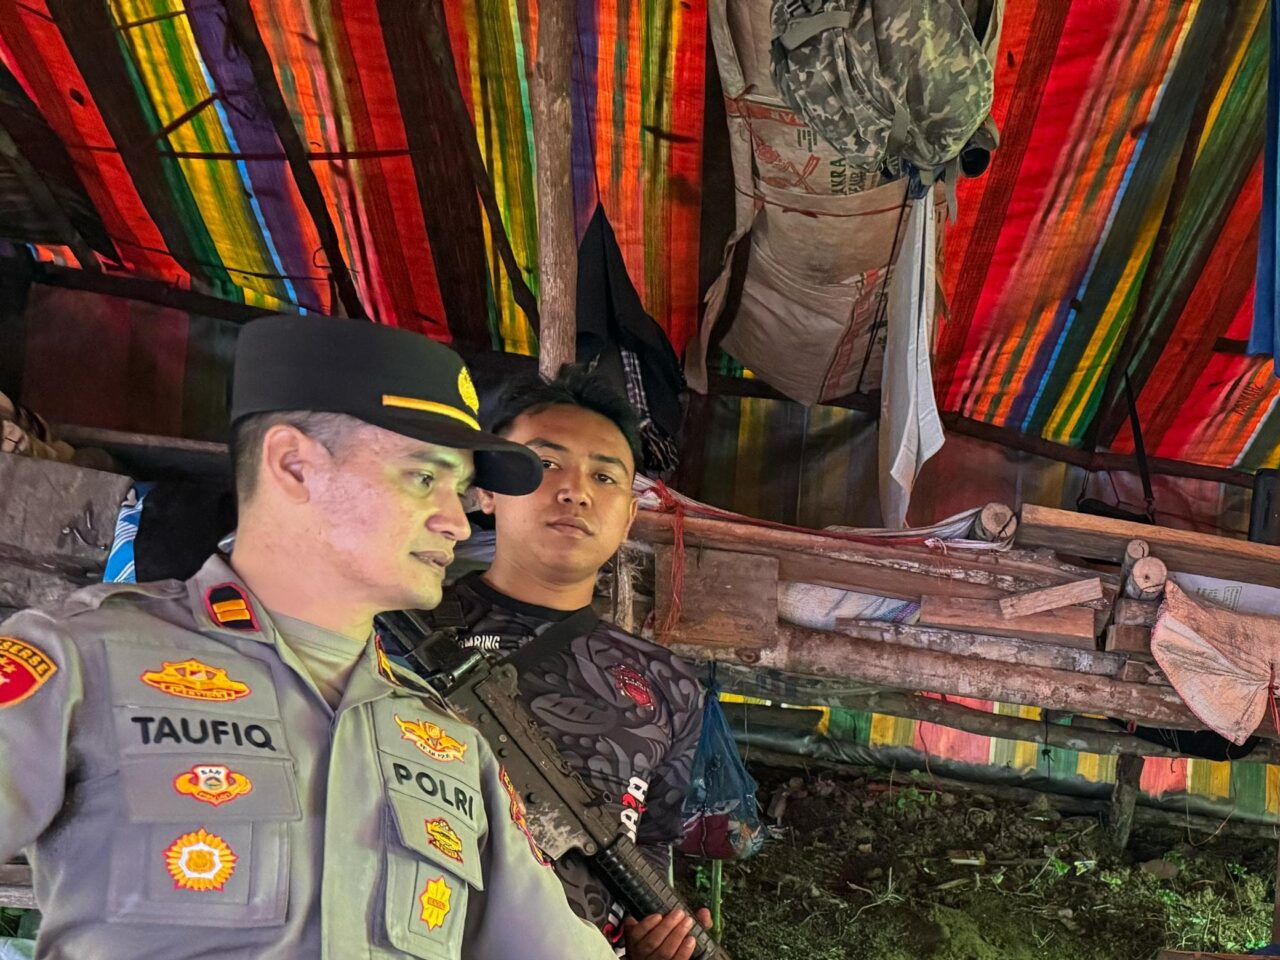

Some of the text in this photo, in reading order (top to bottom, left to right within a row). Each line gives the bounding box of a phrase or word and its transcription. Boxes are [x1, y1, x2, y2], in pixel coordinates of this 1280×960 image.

[0, 641, 48, 674] SERSE
[131, 716, 277, 751] TAUFIQ
[393, 762, 473, 820] POLRI
